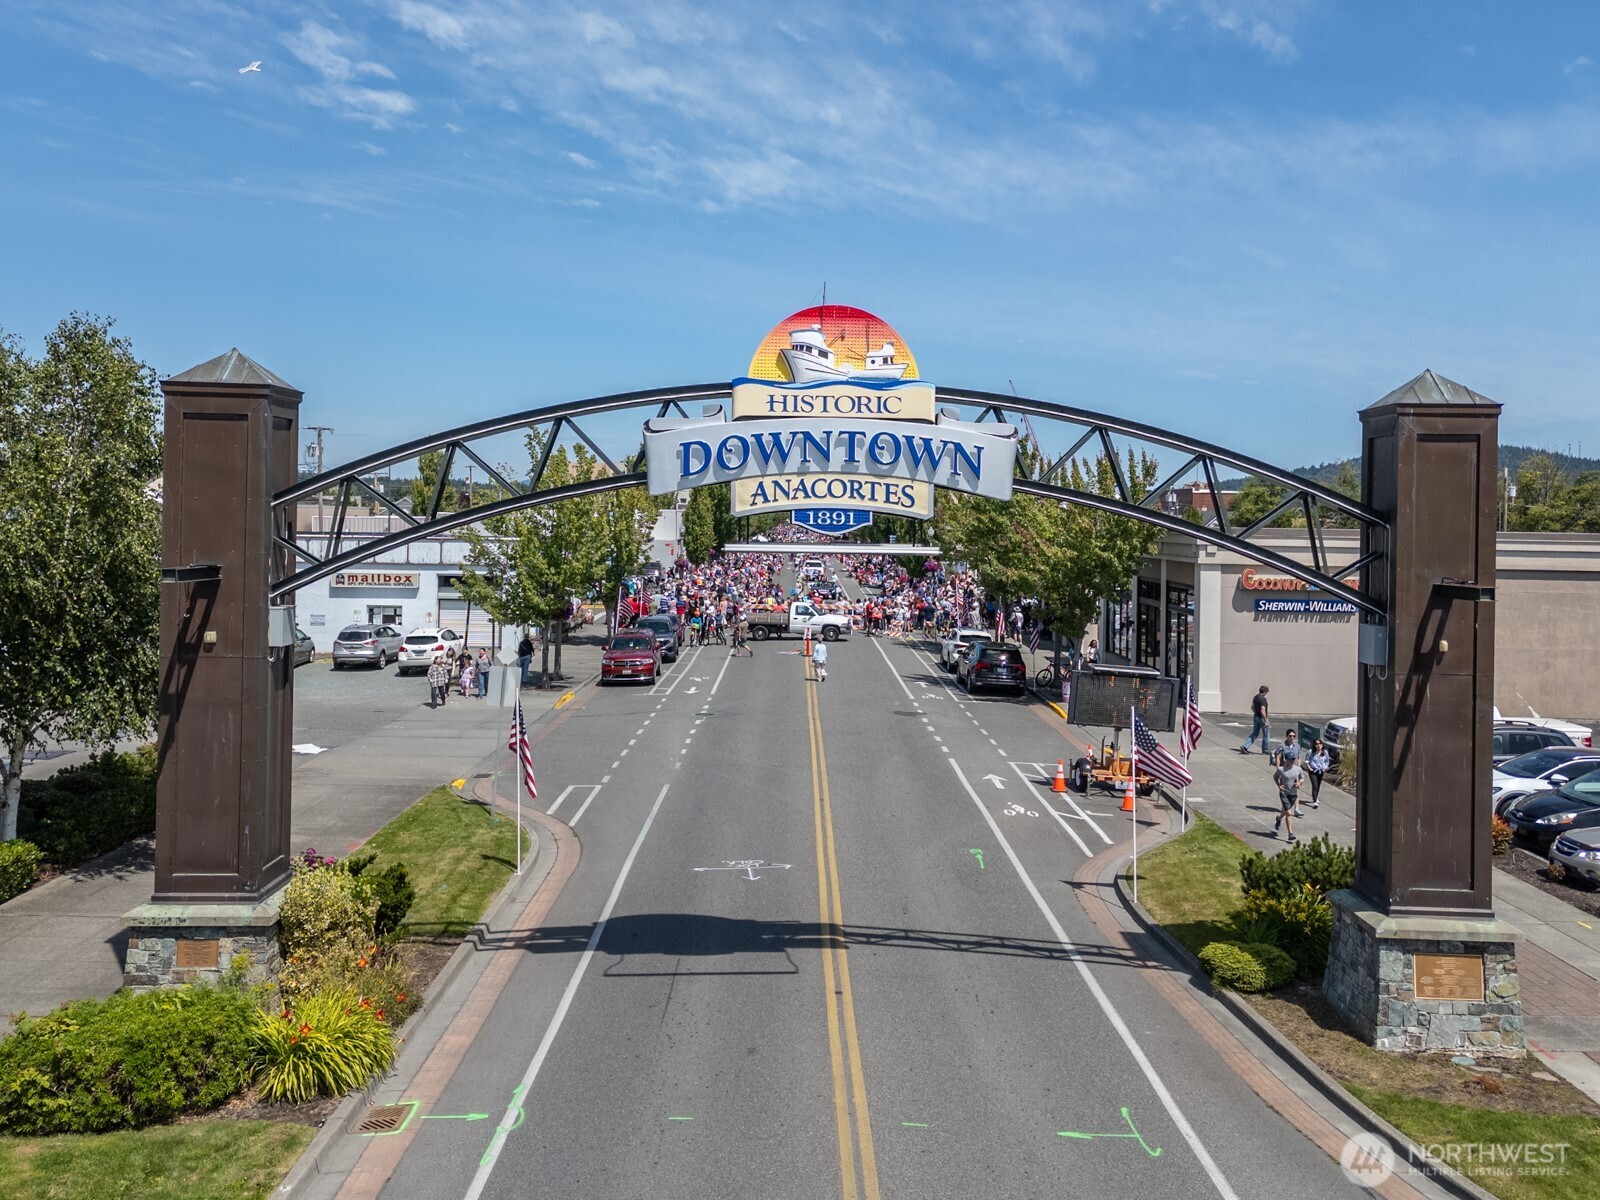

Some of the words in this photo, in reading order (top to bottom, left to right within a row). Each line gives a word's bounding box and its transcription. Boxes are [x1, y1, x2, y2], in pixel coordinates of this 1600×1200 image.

[766, 394, 902, 414] HISTORIC
[678, 430, 984, 479] DOWNTOWN
[750, 477, 916, 508] ANACORTES
[806, 511, 856, 525] 1891
[347, 574, 412, 582] mailbox
[1258, 600, 1357, 612] SHERWIN-WILLIAMS
